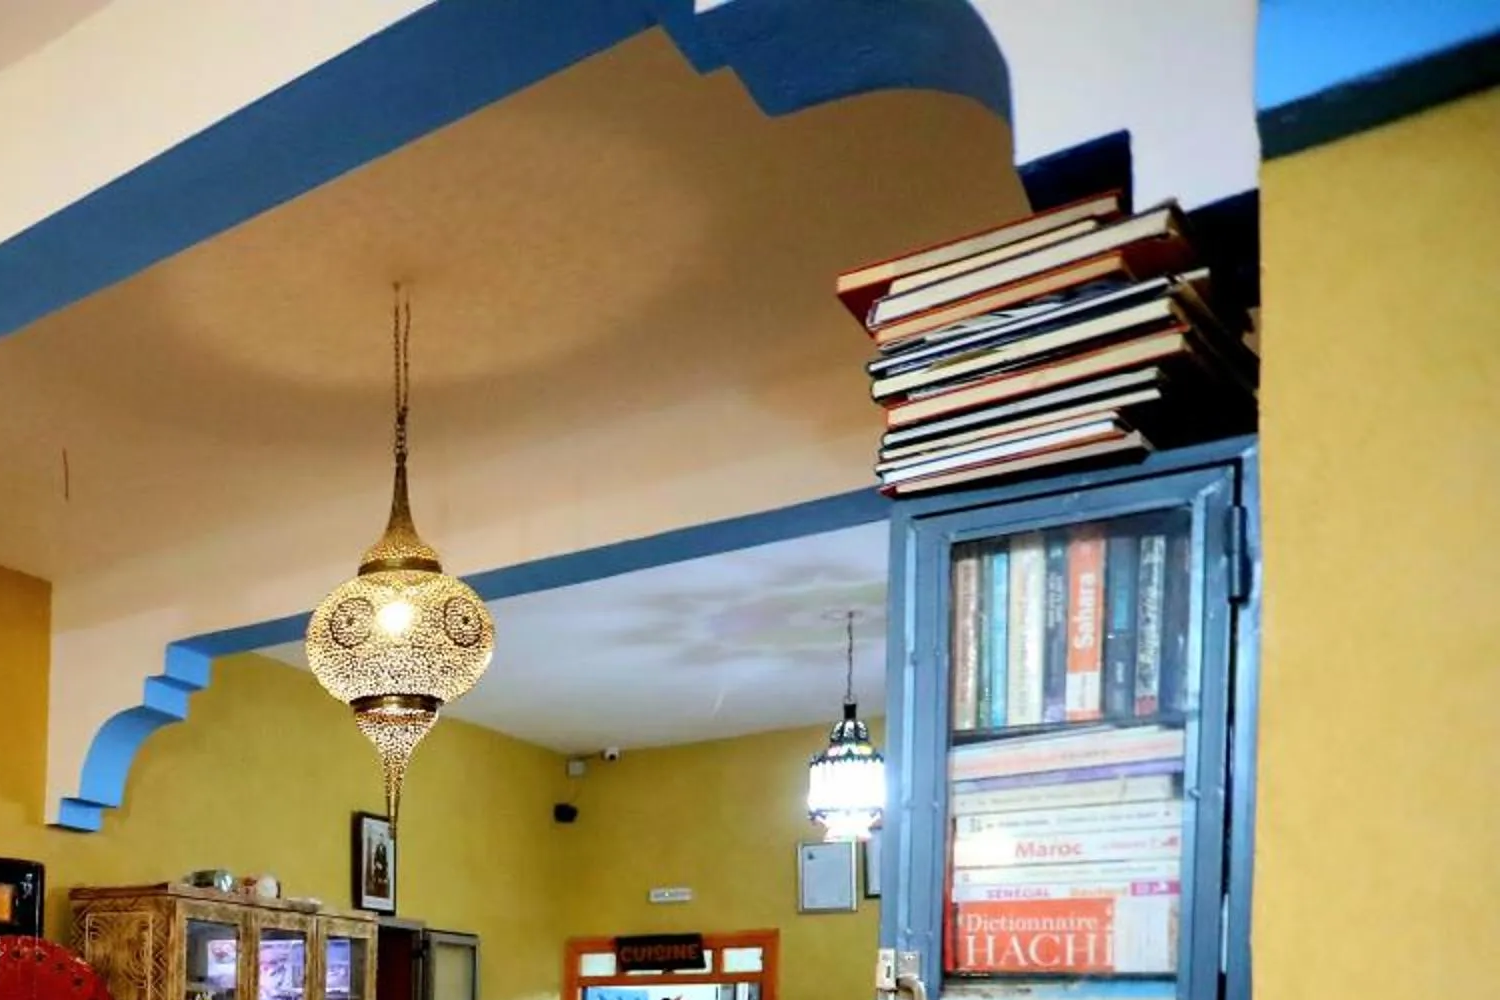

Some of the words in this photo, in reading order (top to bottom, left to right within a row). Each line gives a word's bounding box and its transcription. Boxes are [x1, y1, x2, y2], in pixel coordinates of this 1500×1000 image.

[1073, 572, 1097, 651] Sahara
[1014, 840, 1083, 860] Maroc
[966, 911, 1099, 933] Dictionnaire
[620, 943, 700, 963] CUISINE
